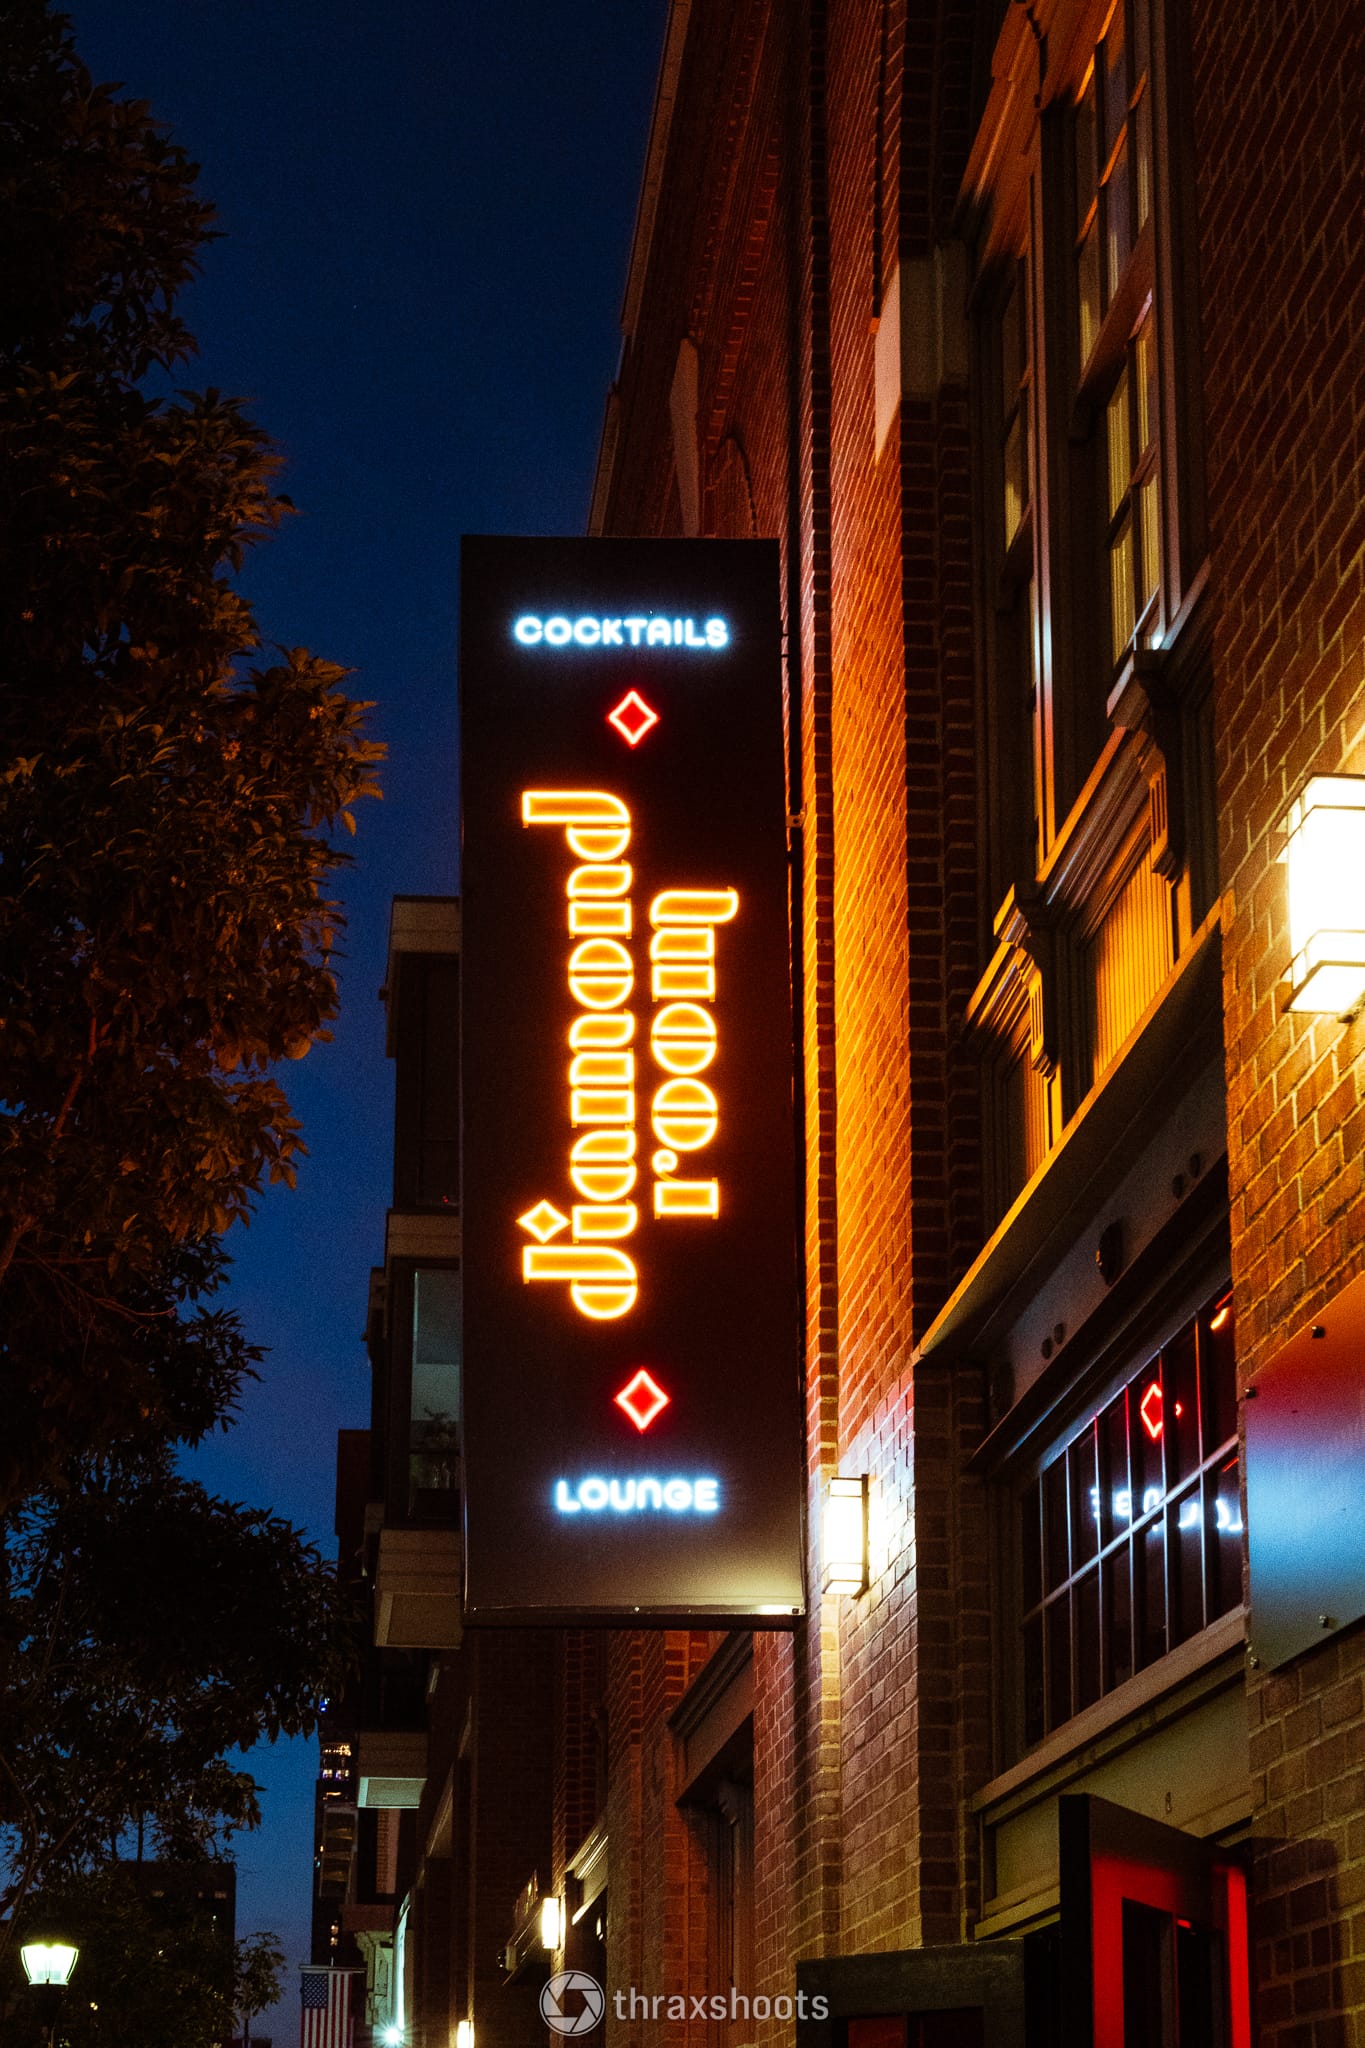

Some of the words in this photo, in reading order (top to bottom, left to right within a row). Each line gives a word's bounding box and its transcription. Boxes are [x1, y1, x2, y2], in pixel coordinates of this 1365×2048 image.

[513, 615, 729, 649] COCKTAILS
[516, 790, 639, 1321] diamond
[649, 886, 740, 1220] room
[555, 1477, 721, 1514] LOUNGE
